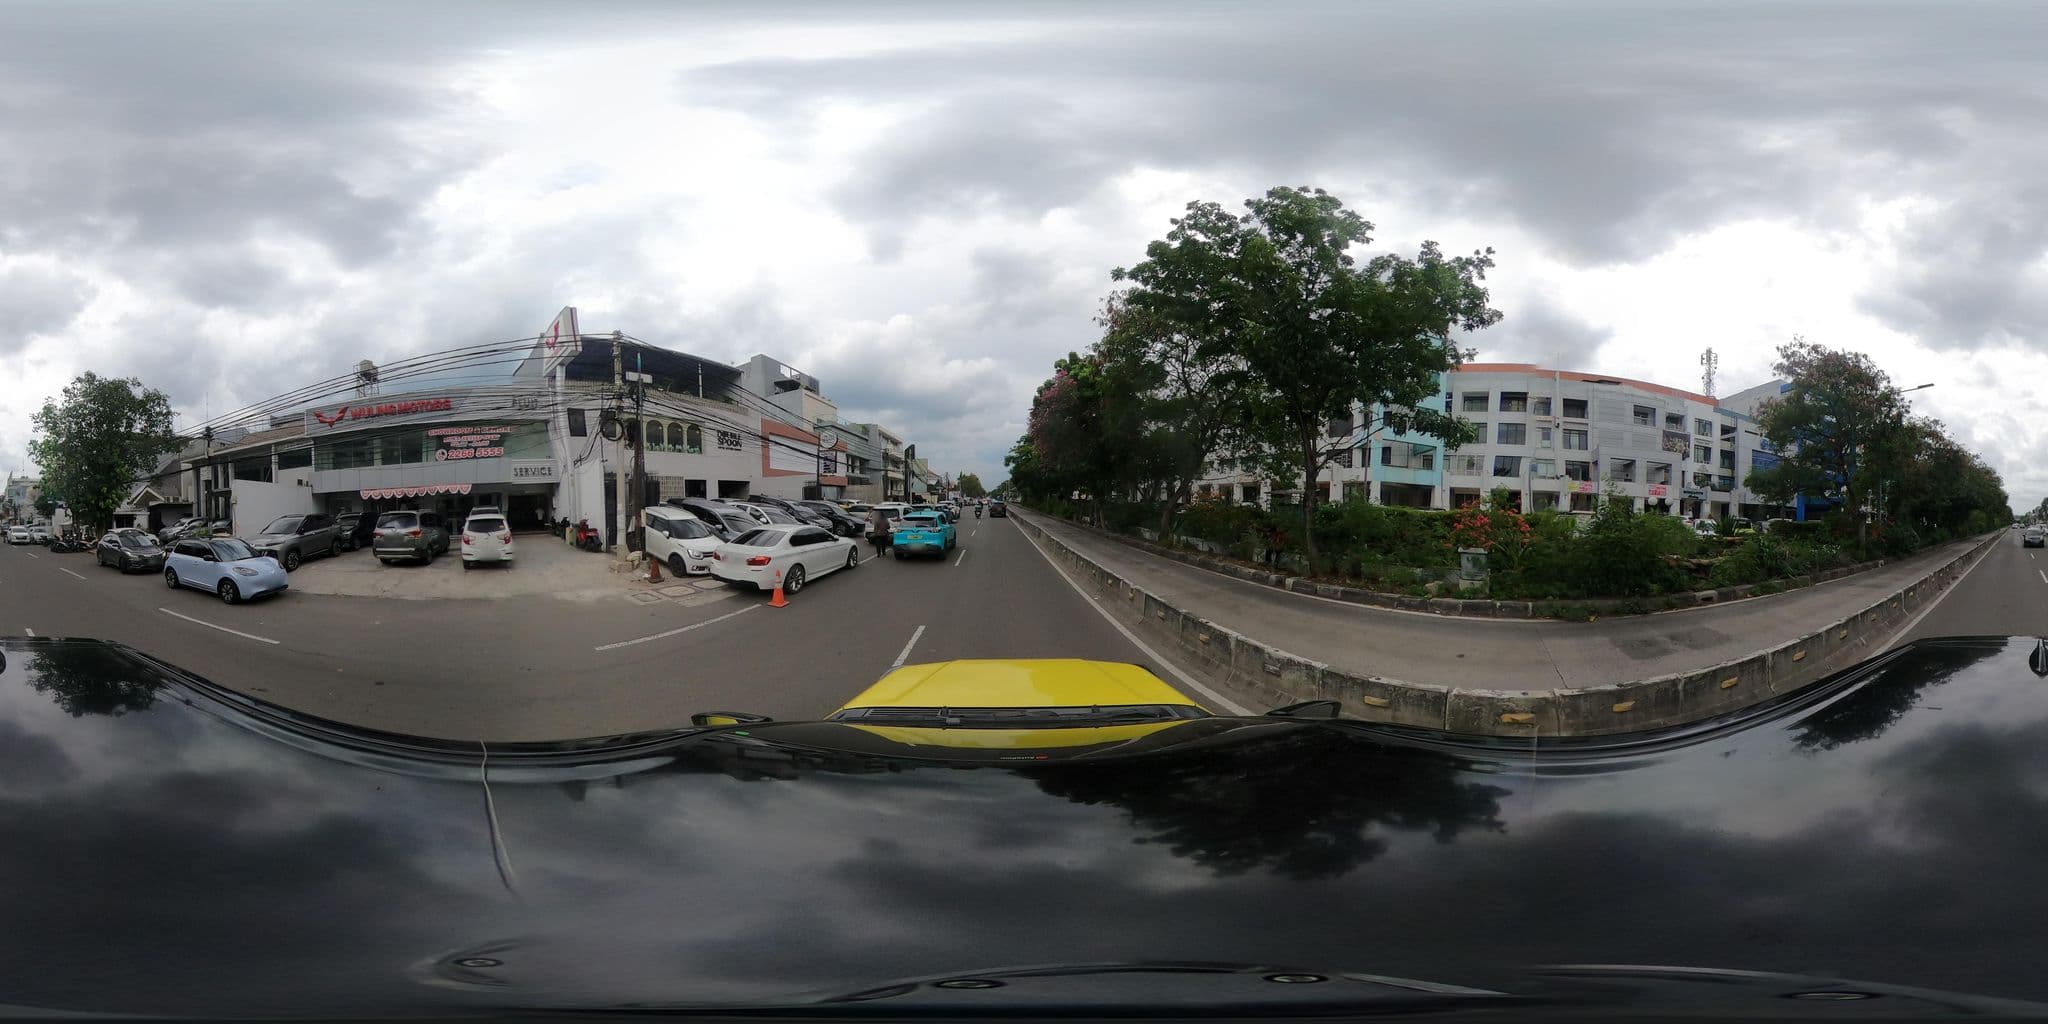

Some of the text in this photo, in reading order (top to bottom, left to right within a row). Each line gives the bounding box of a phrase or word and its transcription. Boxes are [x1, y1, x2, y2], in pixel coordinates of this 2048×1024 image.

[352, 399, 452, 420] WULING MOTORS
[717, 437, 743, 448] SPOON
[475, 447, 504, 457] 5555
[513, 466, 552, 477] SERVICE
